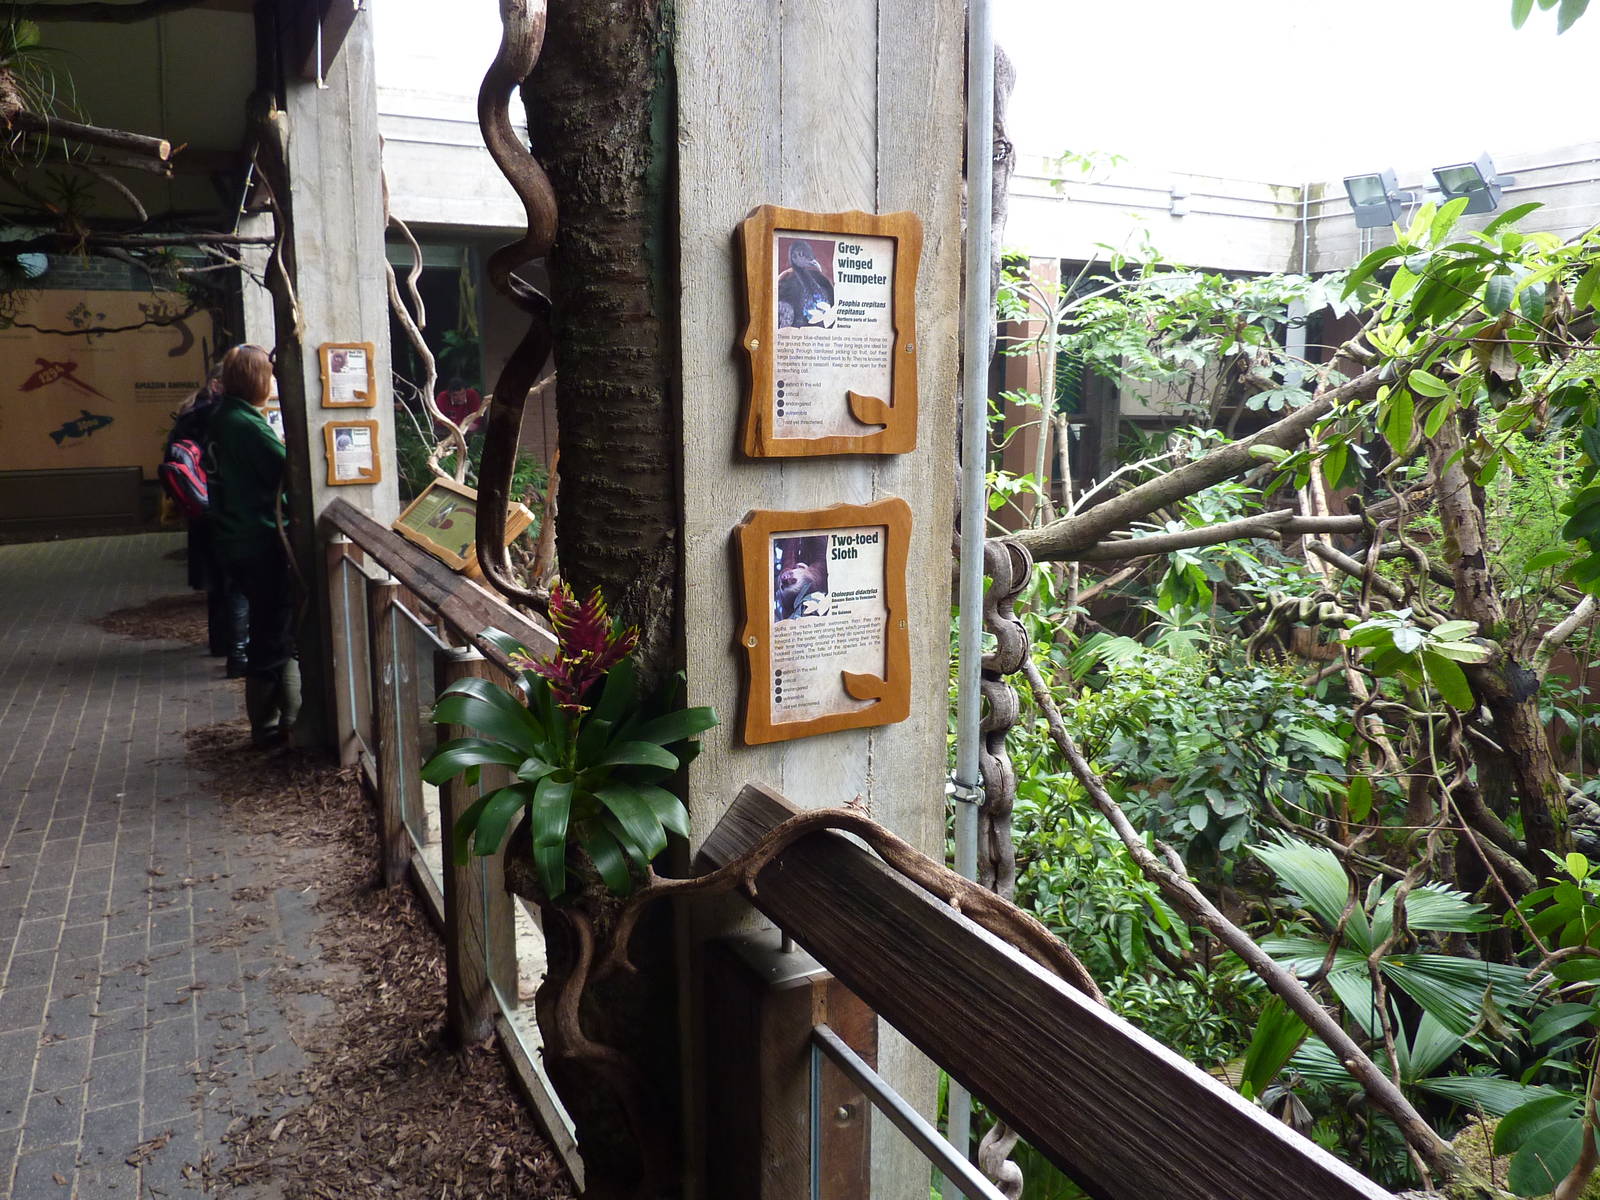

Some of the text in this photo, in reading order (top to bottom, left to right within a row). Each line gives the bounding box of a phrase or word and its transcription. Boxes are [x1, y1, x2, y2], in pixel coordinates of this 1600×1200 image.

[838, 242, 863, 255] Grey-
[838, 257, 872, 270] winged
[838, 272, 887, 285] Trumpeter
[831, 532, 878, 546] Two-toed
[831, 547, 858, 560] Sloth
